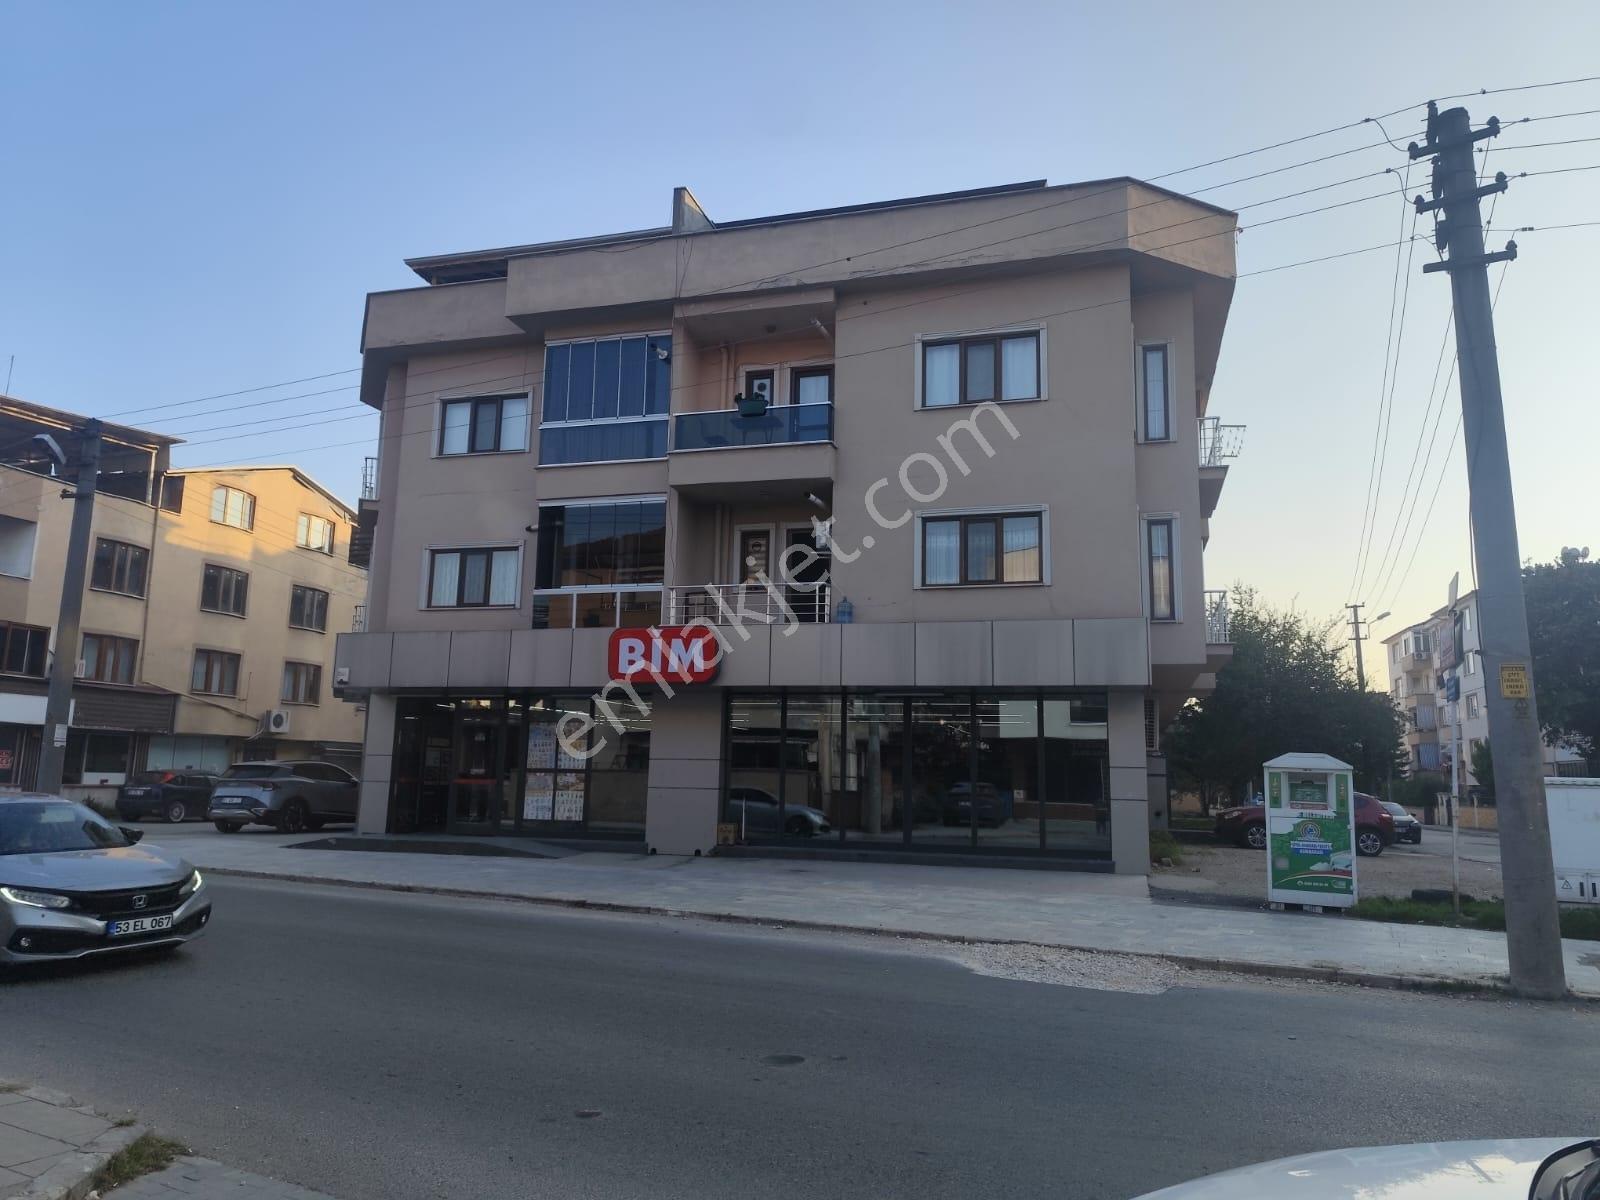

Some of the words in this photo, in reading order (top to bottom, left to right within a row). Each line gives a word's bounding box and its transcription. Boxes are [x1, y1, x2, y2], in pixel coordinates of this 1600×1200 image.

[618, 629, 704, 674] BİM
[116, 922, 130, 933] 53
[133, 920, 147, 931] EL
[151, 917, 171, 928] 067
